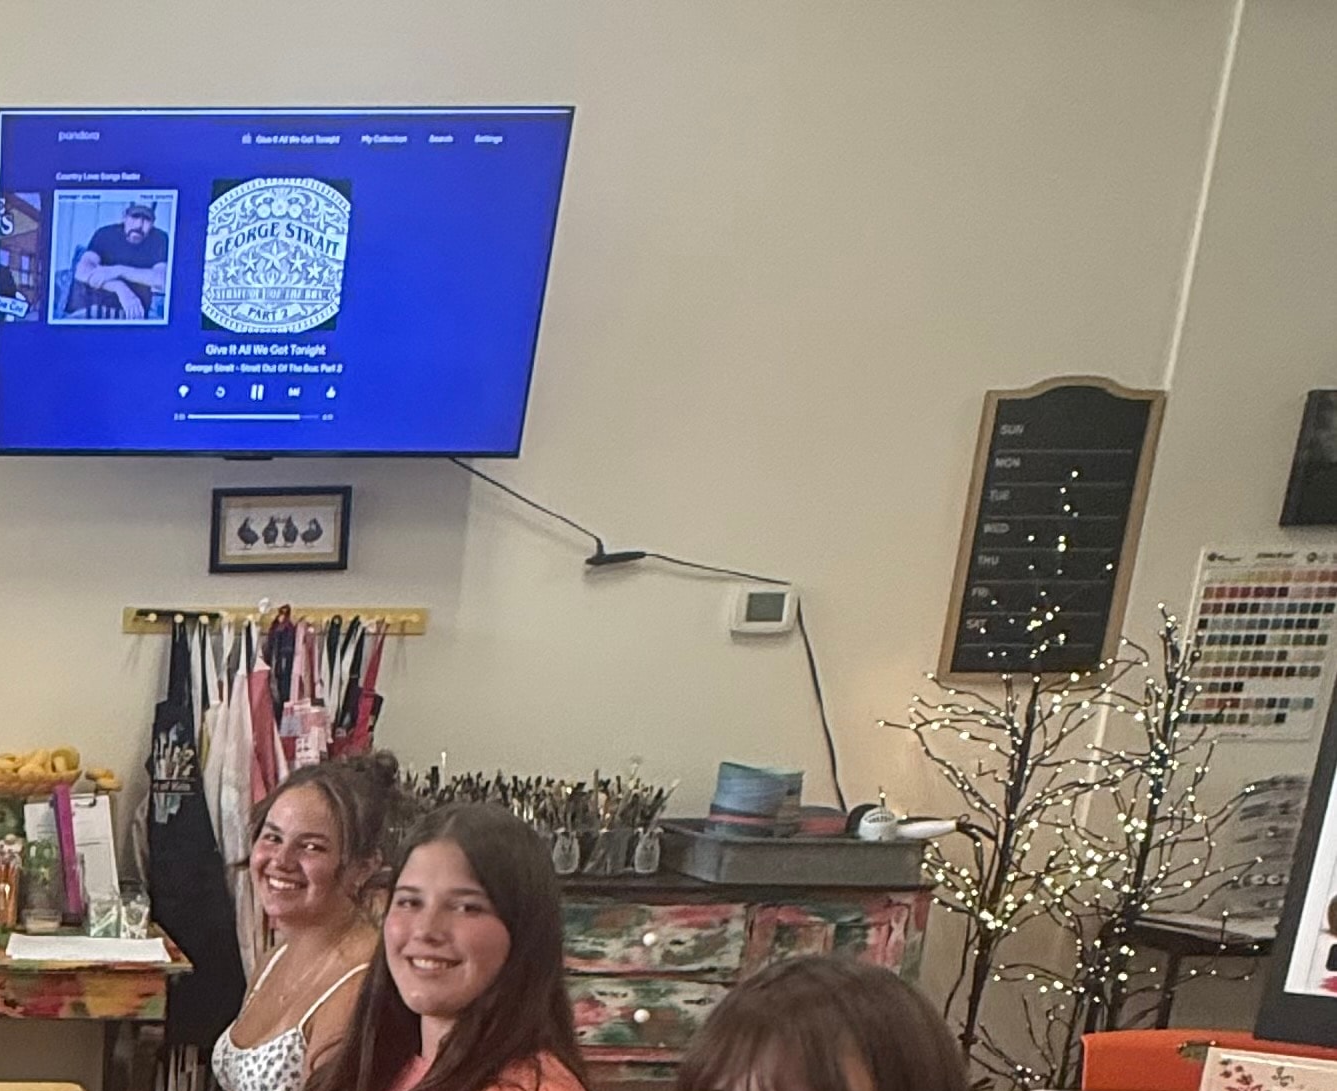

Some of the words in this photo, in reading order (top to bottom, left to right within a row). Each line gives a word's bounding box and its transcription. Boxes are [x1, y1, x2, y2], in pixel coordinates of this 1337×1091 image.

[59, 131, 100, 142] pandora
[56, 172, 83, 182] Country
[83, 172, 100, 181] Love
[213, 222, 280, 256] GEORGE
[285, 222, 340, 256] STRAIT
[248, 309, 277, 321] PART
[205, 344, 228, 355] Give
[229, 344, 237, 355] It
[238, 344, 252, 355] All
[253, 344, 268, 355] We
[270, 344, 289, 355] Got
[290, 344, 327, 358] Tonight
[185, 363, 214, 374] George
[214, 363, 235, 373] Strait
[240, 363, 261, 373] Strait
[262, 363, 277, 373] Out
[289, 363, 303, 373] The
[1000, 424, 1024, 434] SUN
[995, 458, 1021, 468] MON
[977, 555, 1000, 566] THU
[966, 618, 988, 629] SAT
